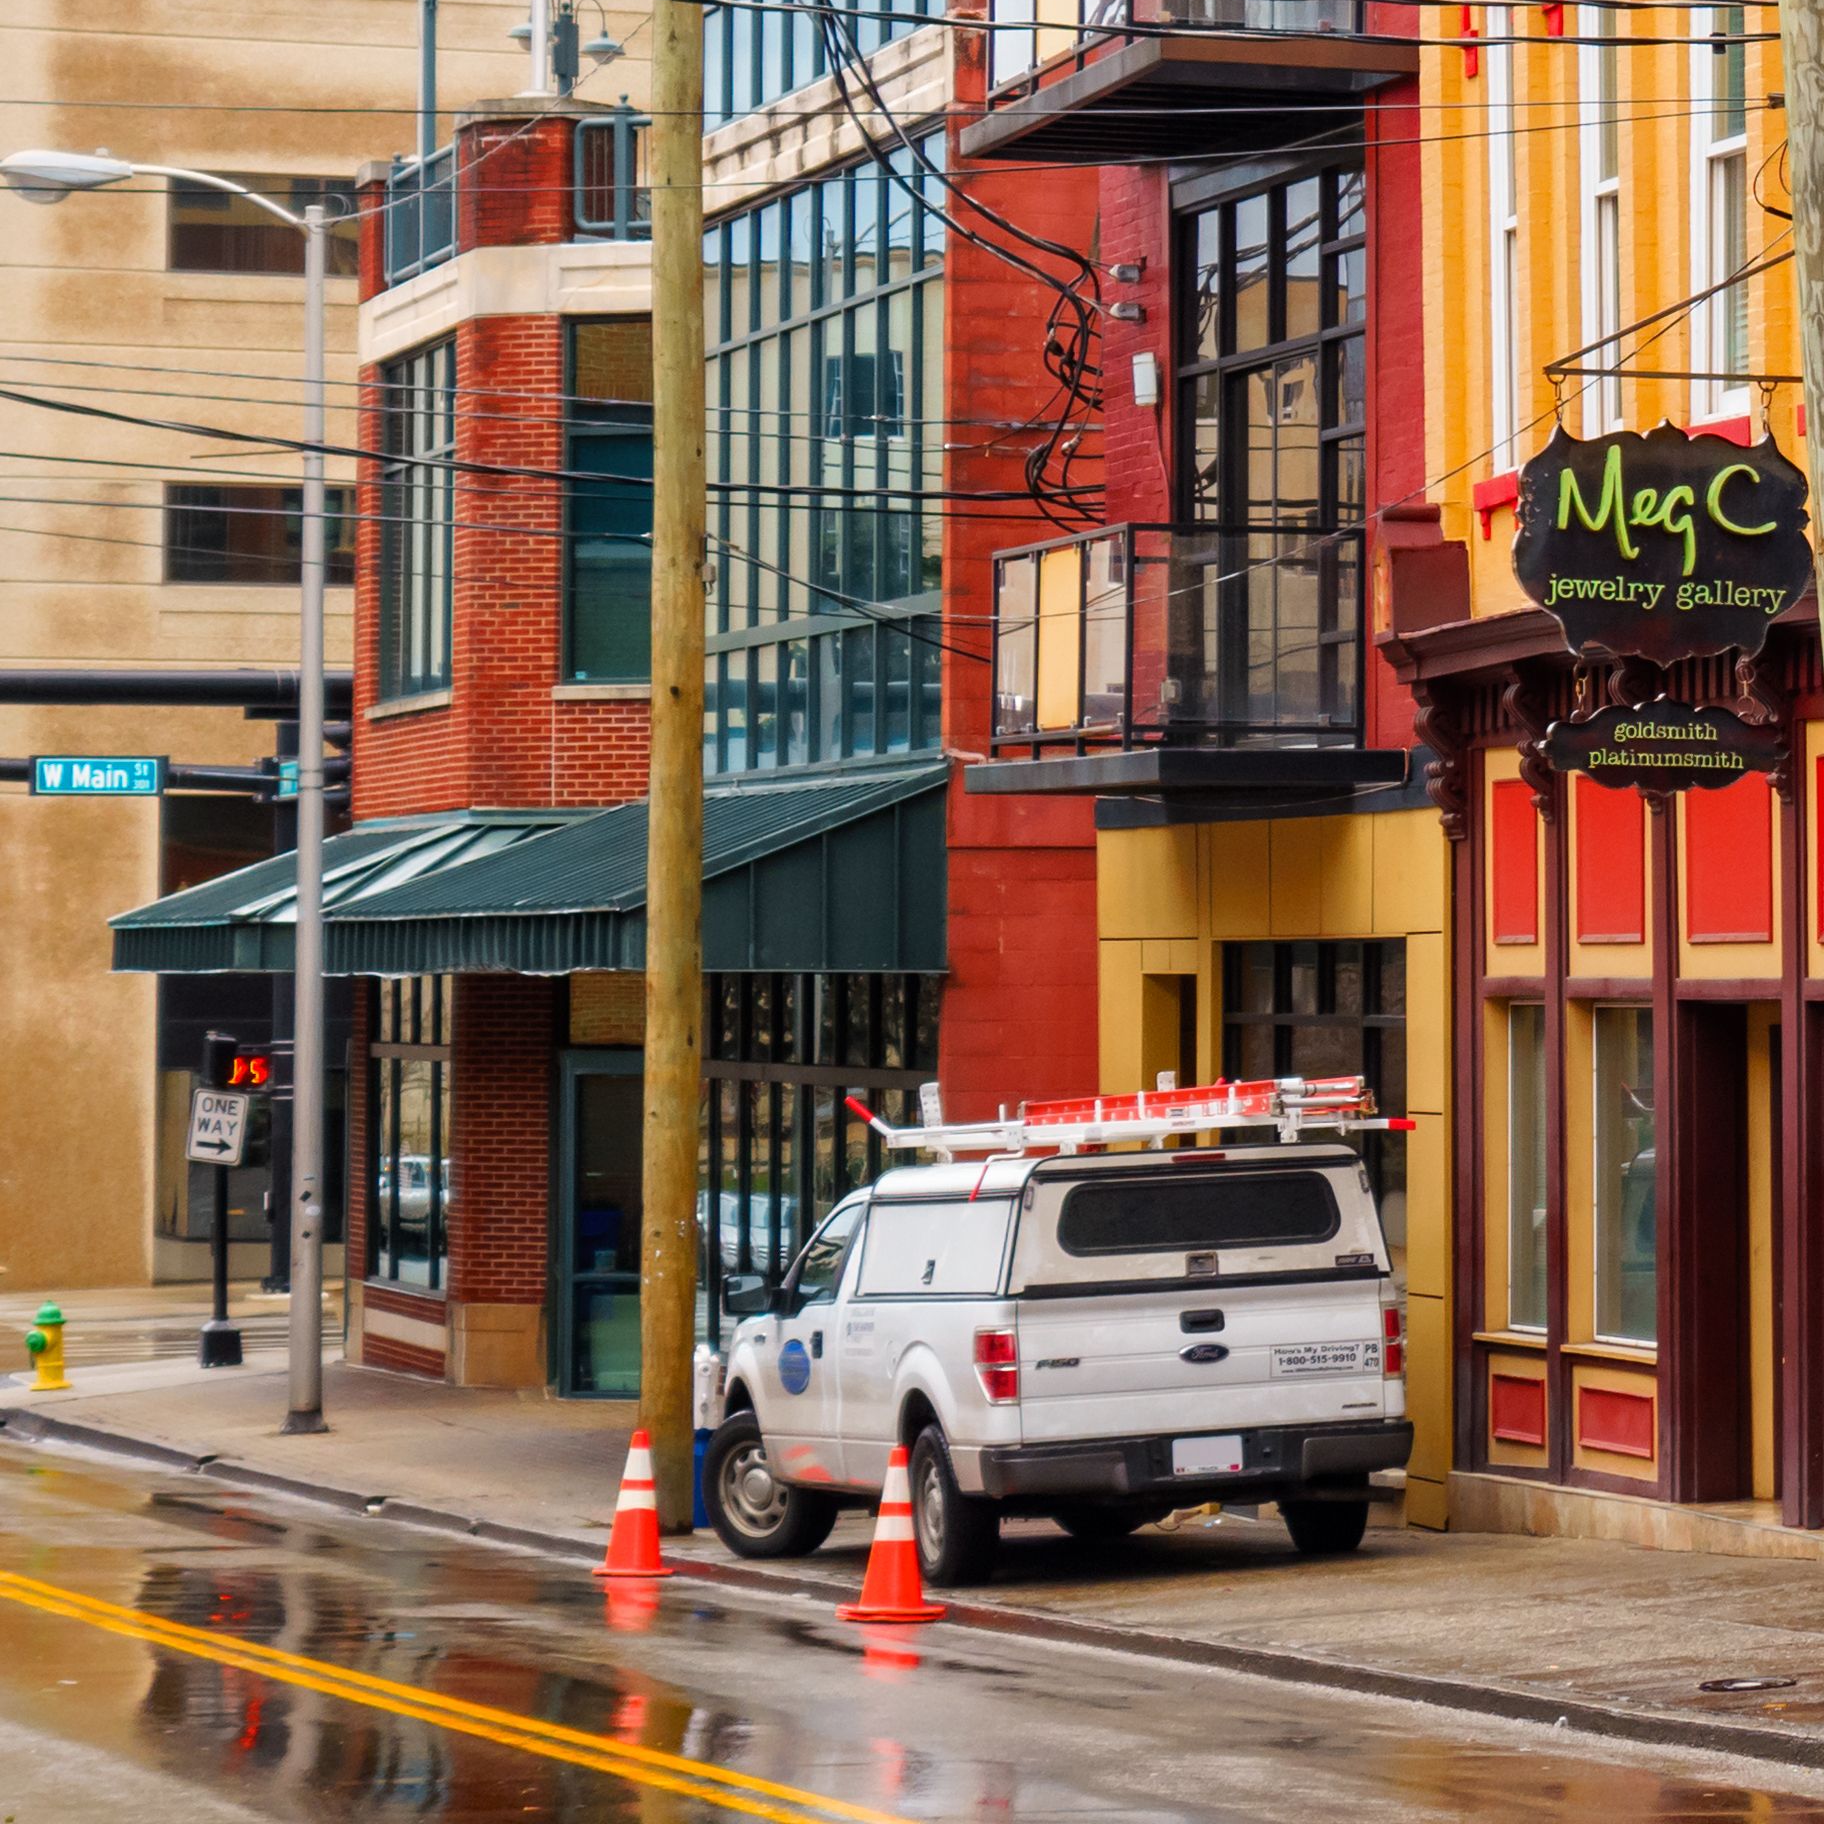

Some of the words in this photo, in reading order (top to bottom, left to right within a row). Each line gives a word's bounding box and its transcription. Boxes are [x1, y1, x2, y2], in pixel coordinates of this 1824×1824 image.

[1557, 444, 1695, 576] Meg
[1705, 464, 1777, 536] C
[1544, 575, 1666, 610] jewelry
[1676, 580, 1787, 614] gallery
[1613, 721, 1718, 742] goldsmith
[1589, 749, 1744, 770] platinumsmith
[43, 763, 63, 788] W
[72, 763, 128, 788] Main
[133, 762, 149, 776] St
[201, 1096, 239, 1116] ONE
[197, 1116, 238, 1136] WAY
